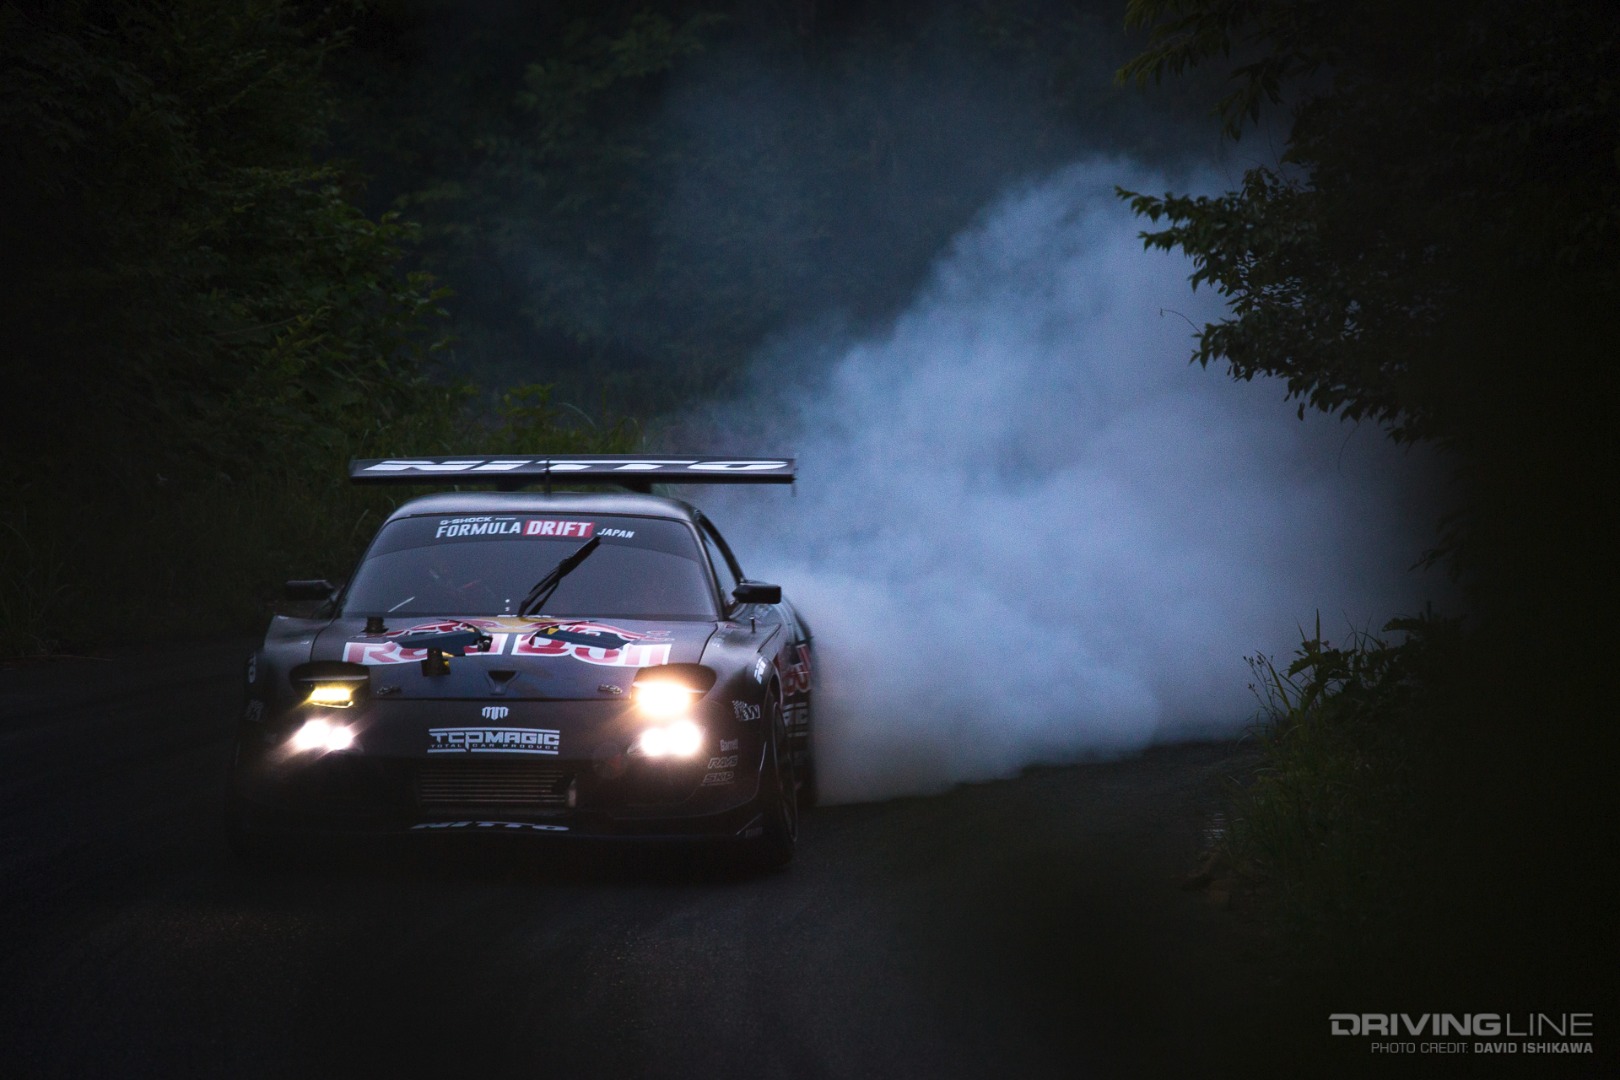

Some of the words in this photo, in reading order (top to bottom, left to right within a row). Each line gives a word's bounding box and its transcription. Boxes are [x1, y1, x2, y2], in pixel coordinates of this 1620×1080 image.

[363, 460, 789, 471] NITTO
[440, 516, 492, 525] G-SHOCK
[435, 521, 521, 539] FORMULA
[526, 520, 591, 537] DRIFT
[597, 528, 635, 539] JAPAN
[410, 821, 570, 831] NITTO
